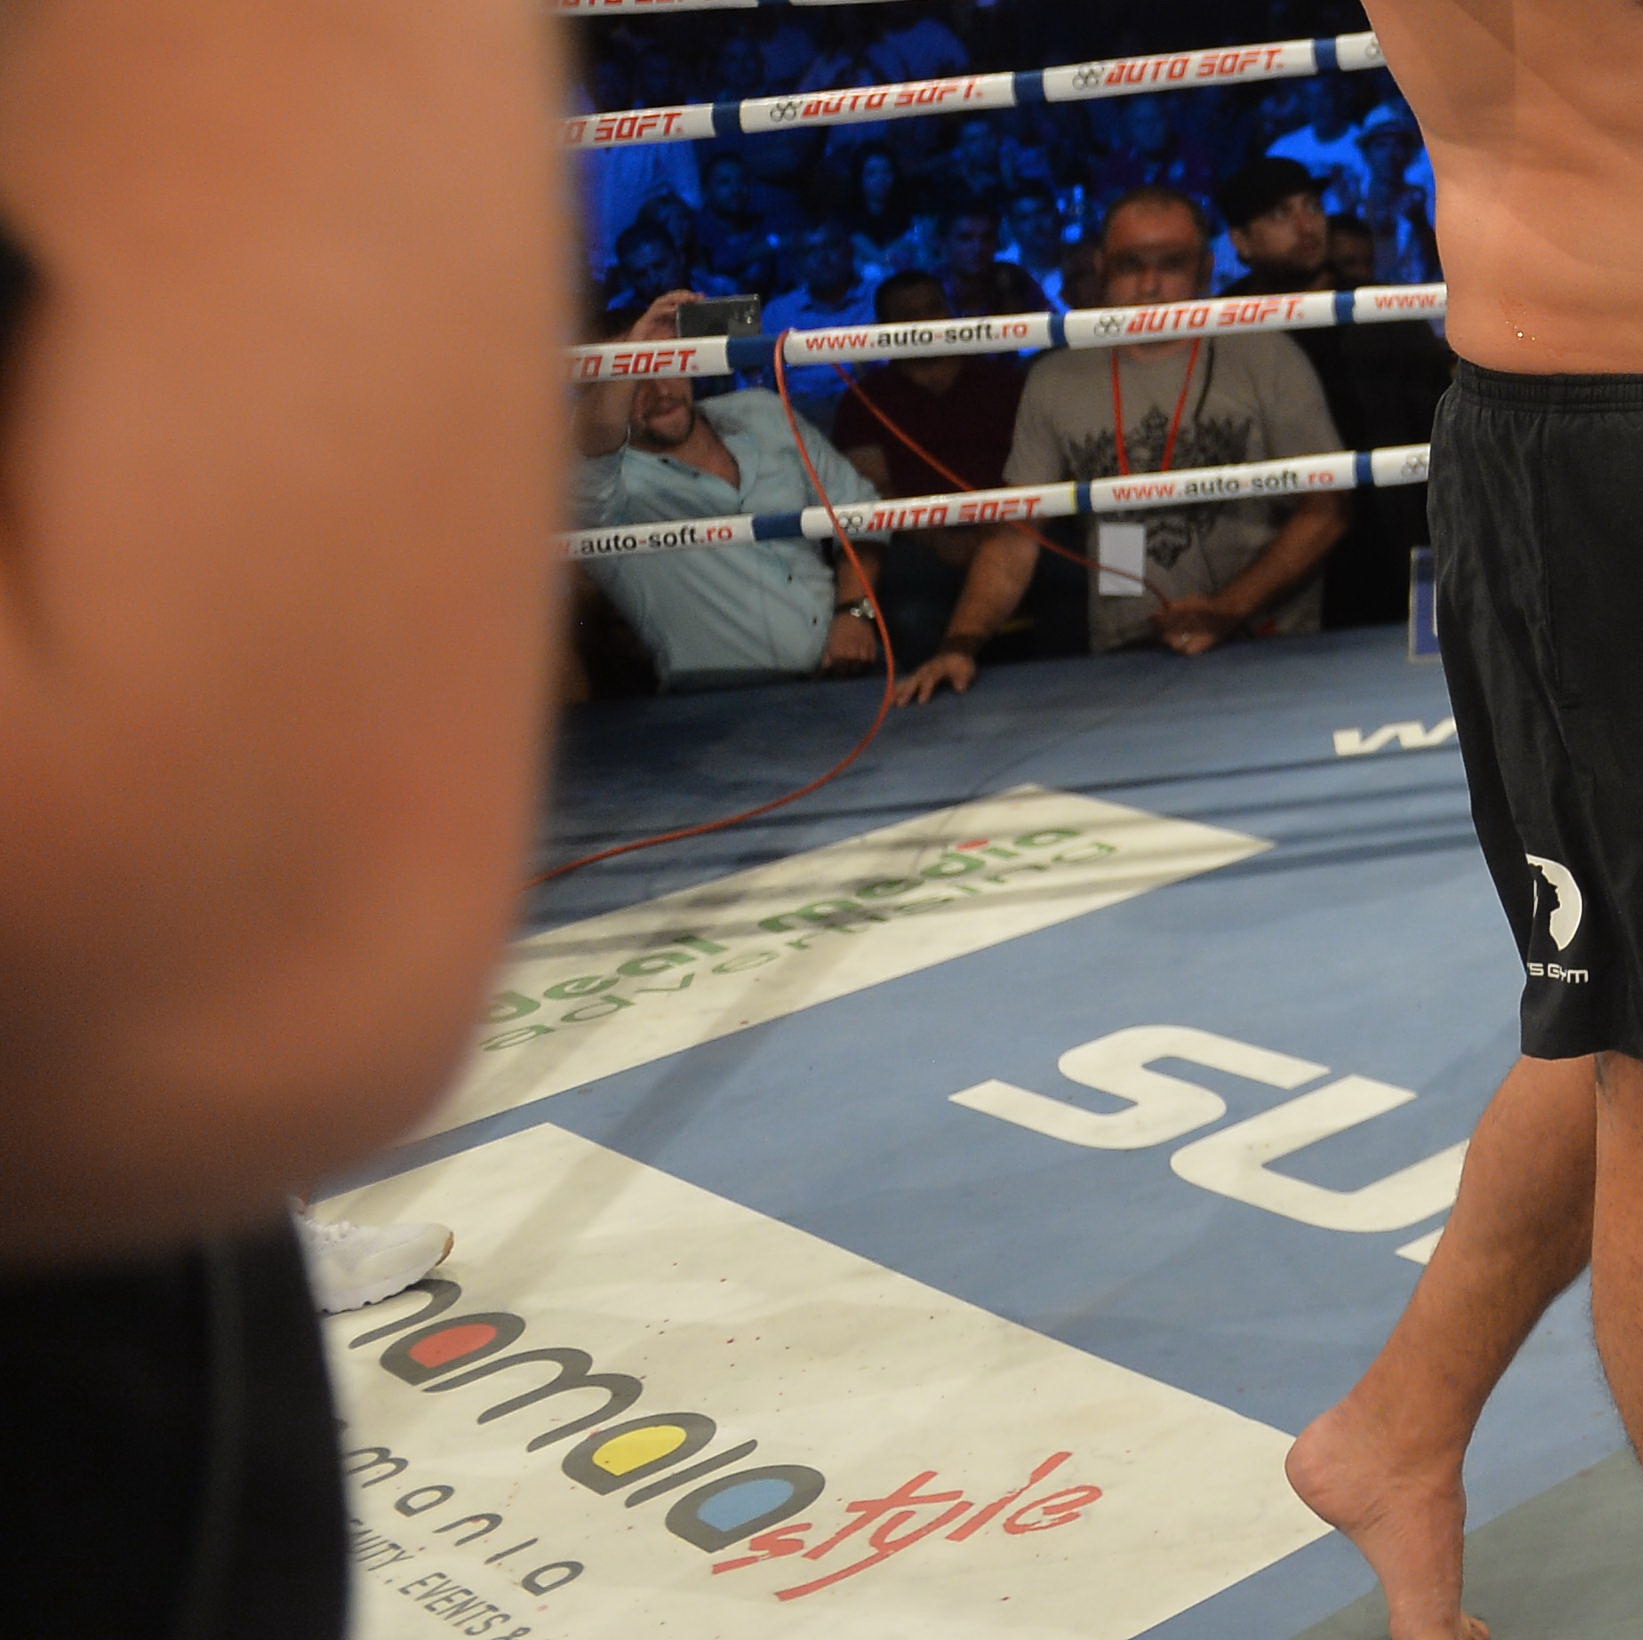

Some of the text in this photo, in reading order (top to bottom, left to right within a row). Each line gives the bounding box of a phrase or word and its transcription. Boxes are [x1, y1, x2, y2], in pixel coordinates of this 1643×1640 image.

[1104, 56, 1190, 87] AUTO
[802, 92, 889, 118] AUTO
[1127, 305, 1209, 334] AUTO
[805, 321, 1029, 351] www.auto-soft.ro
[1112, 468, 1335, 501] www.auto-soft.ro
[866, 506, 948, 531] AUTO
[398, 1572, 510, 1637] EVENTS
